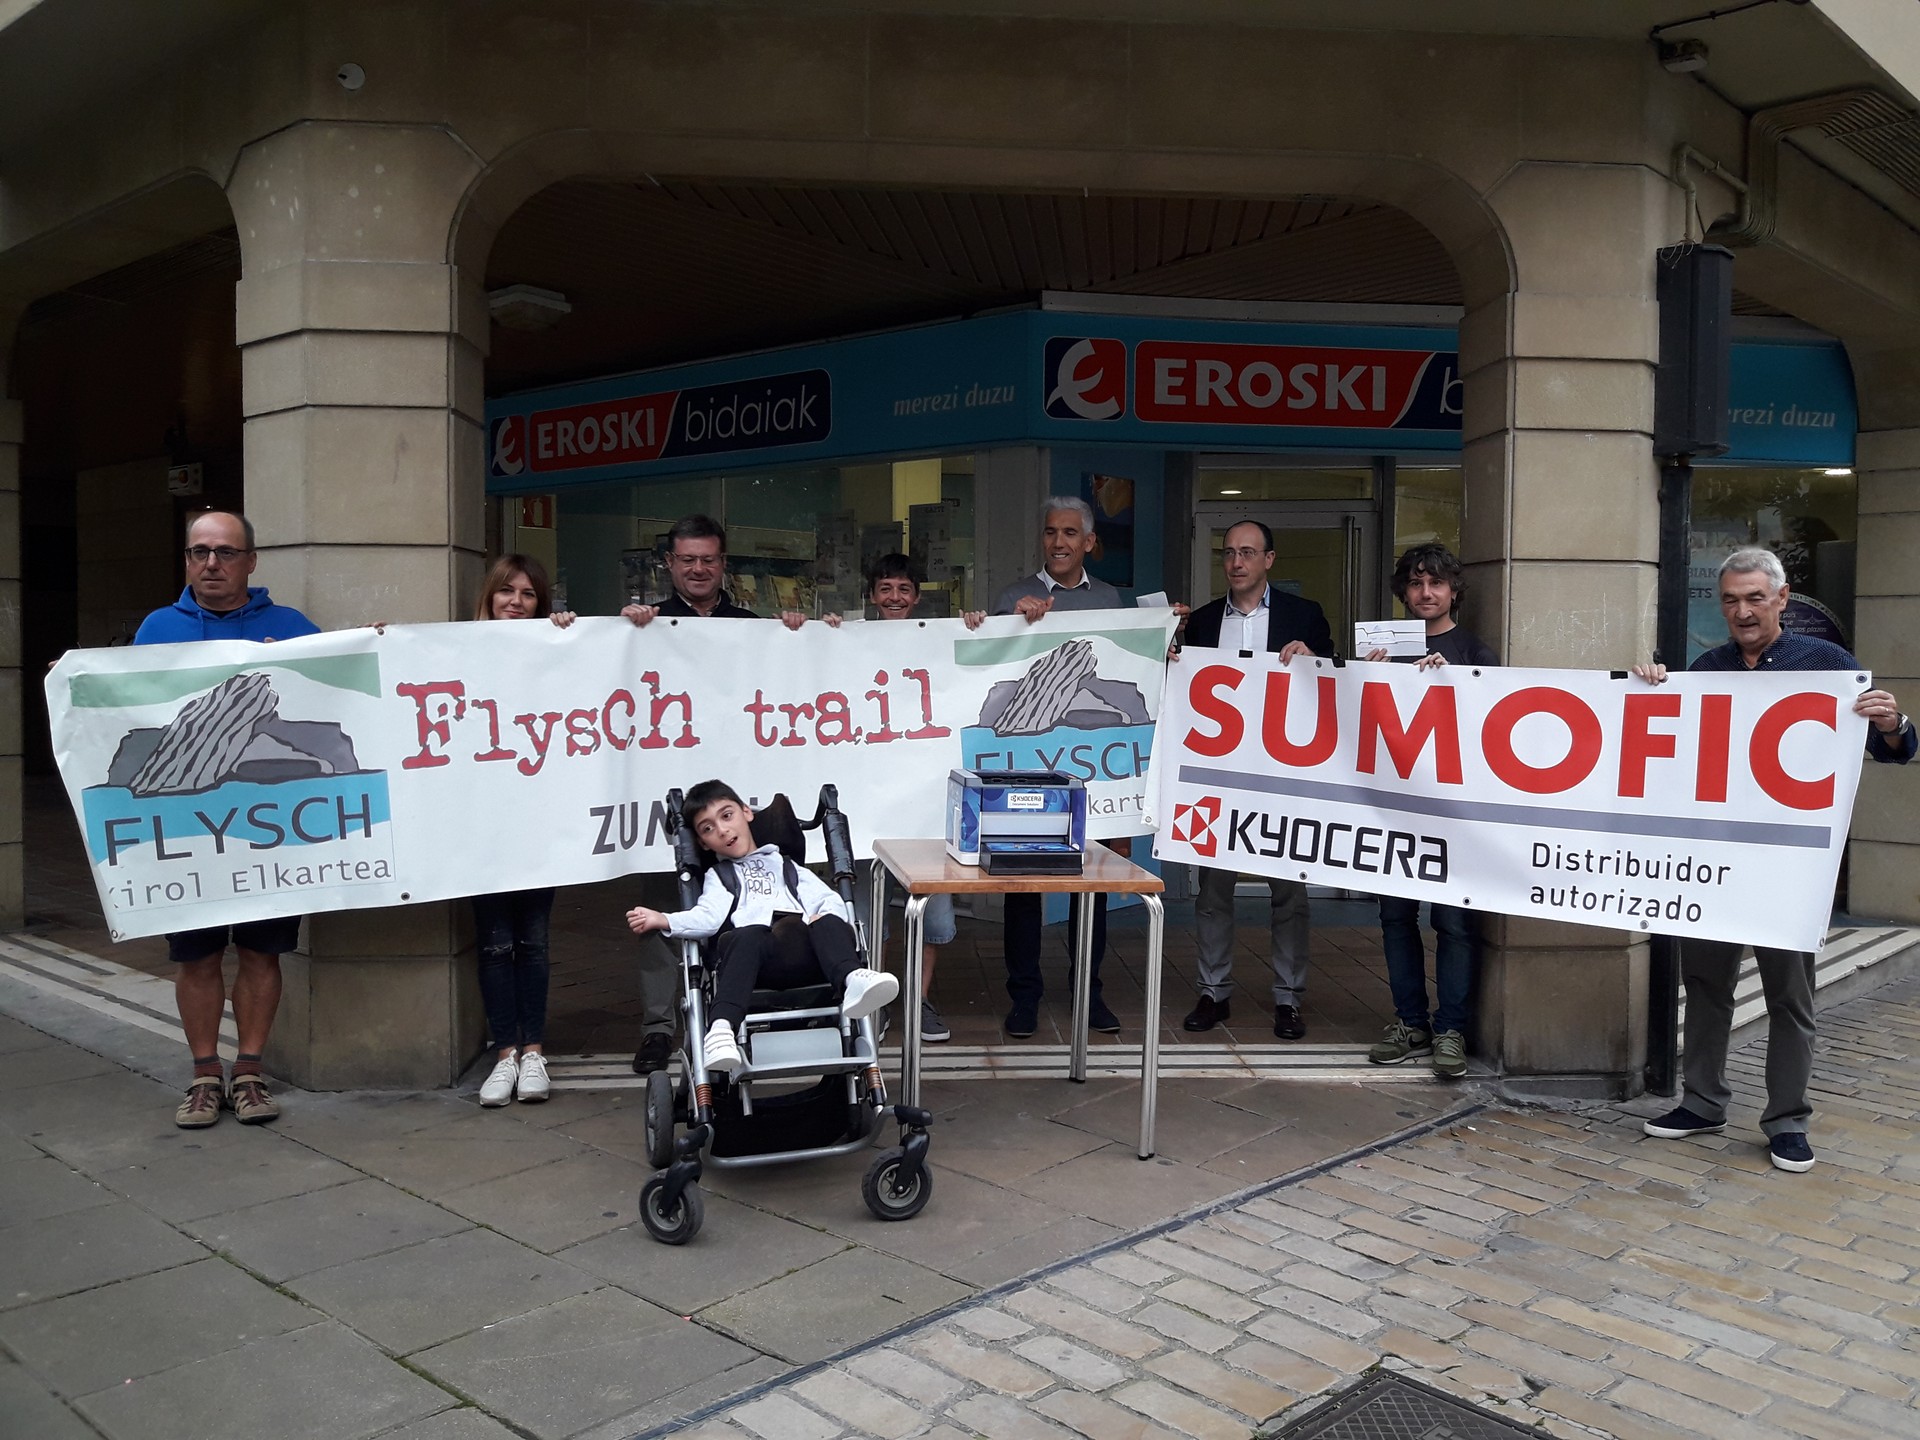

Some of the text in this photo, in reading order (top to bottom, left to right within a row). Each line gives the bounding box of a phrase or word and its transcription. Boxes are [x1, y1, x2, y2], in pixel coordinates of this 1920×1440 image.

[893, 381, 1015, 417] merezi duzu
[1153, 357, 1387, 412] EROSKI
[537, 384, 818, 460] EROSKI bidaiak
[1727, 402, 1836, 428] rezi duzu
[396, 668, 952, 777] Flysch trail
[1182, 664, 1838, 811] SUMOFIC
[105, 794, 373, 867] FLYSCH
[1088, 793, 1145, 815] kart
[108, 855, 392, 909] irol Elkartea
[1531, 842, 1732, 886] Distribuidor
[1530, 883, 1703, 924] autorizado
